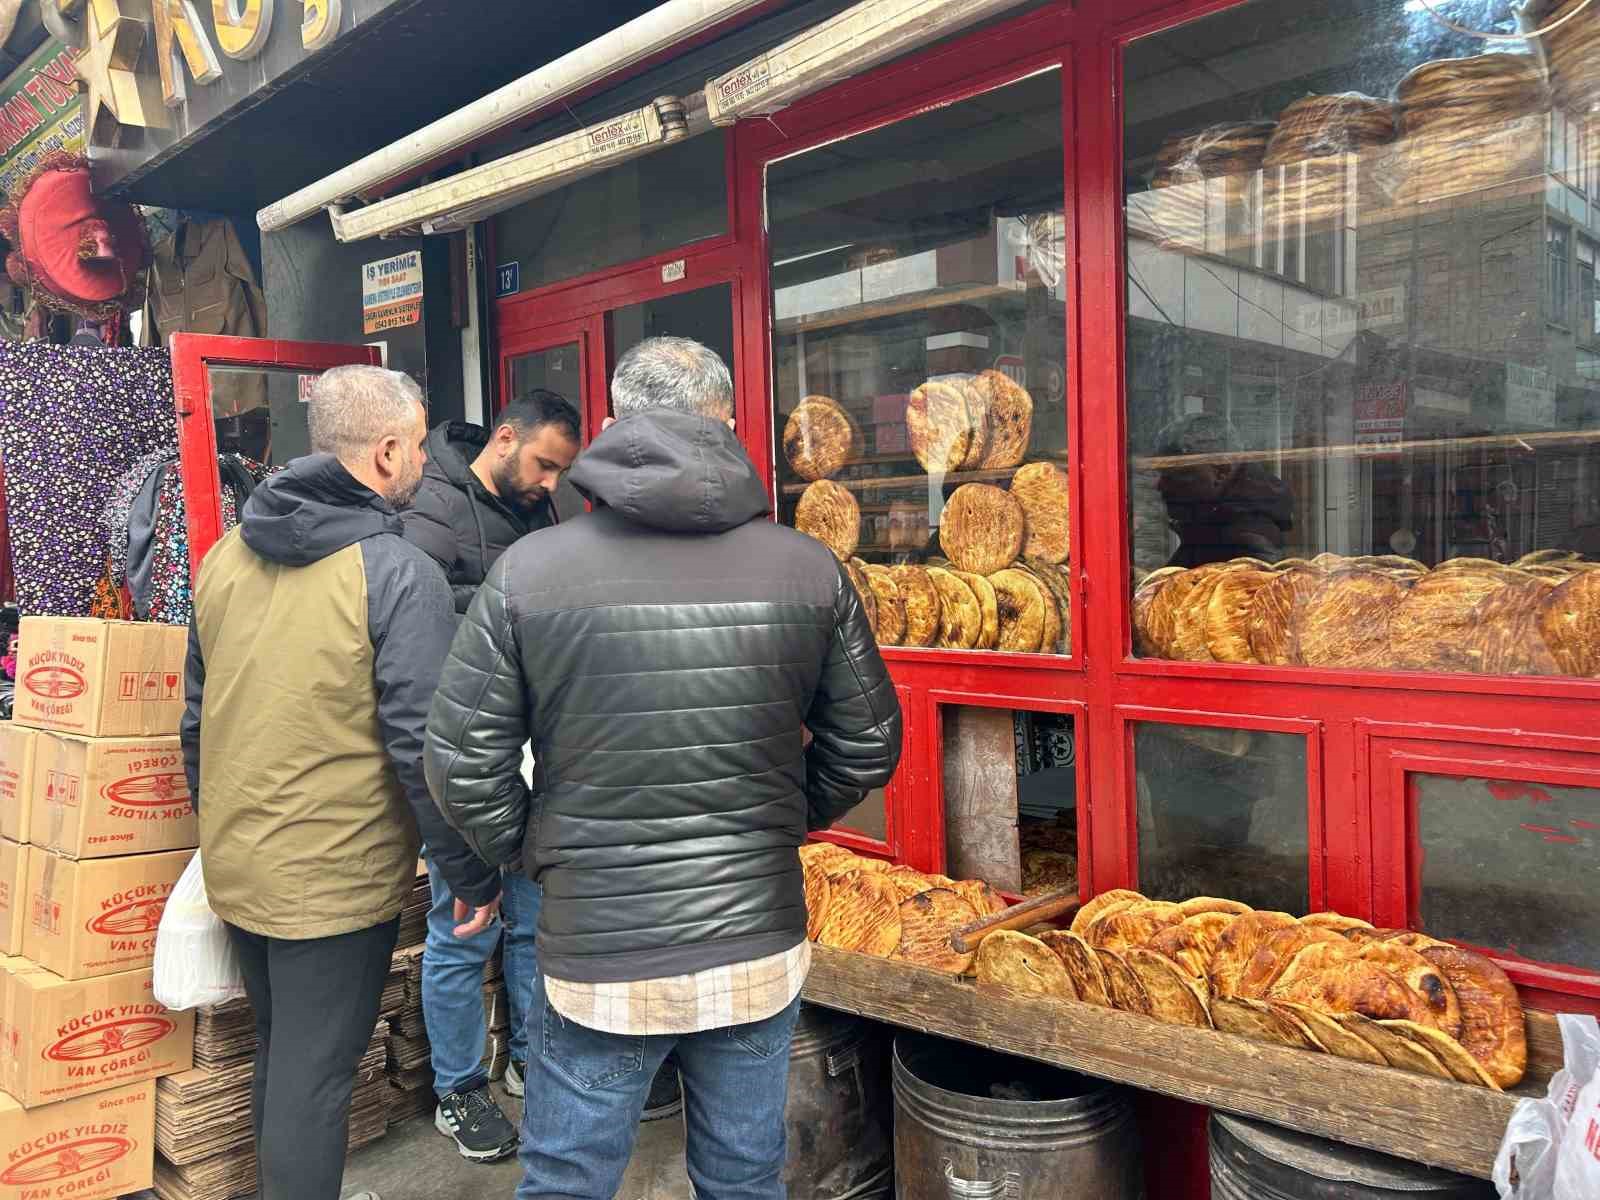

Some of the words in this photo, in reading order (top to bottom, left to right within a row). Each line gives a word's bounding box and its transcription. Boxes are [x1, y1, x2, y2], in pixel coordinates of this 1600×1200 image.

[720, 69, 753, 97] Tentex
[378, 254, 417, 277] YERİMİZ
[28, 648, 57, 667] KÜÇÜK
[58, 651, 86, 672] YILDIZ
[31, 698, 45, 713] VAN
[108, 804, 158, 820] YILDIZ
[100, 884, 157, 911] KÜÇÜK
[110, 940, 137, 951] VAN
[57, 1006, 115, 1038] KÜÇÜK
[119, 1003, 169, 1017] YILDIZ
[67, 1065, 96, 1077] VAN
[98, 1099, 125, 1110] Since
[8, 1129, 71, 1162] KÜÇÜK
[75, 1123, 129, 1137] YILDIZ
[20, 1188, 51, 1200] VAN
